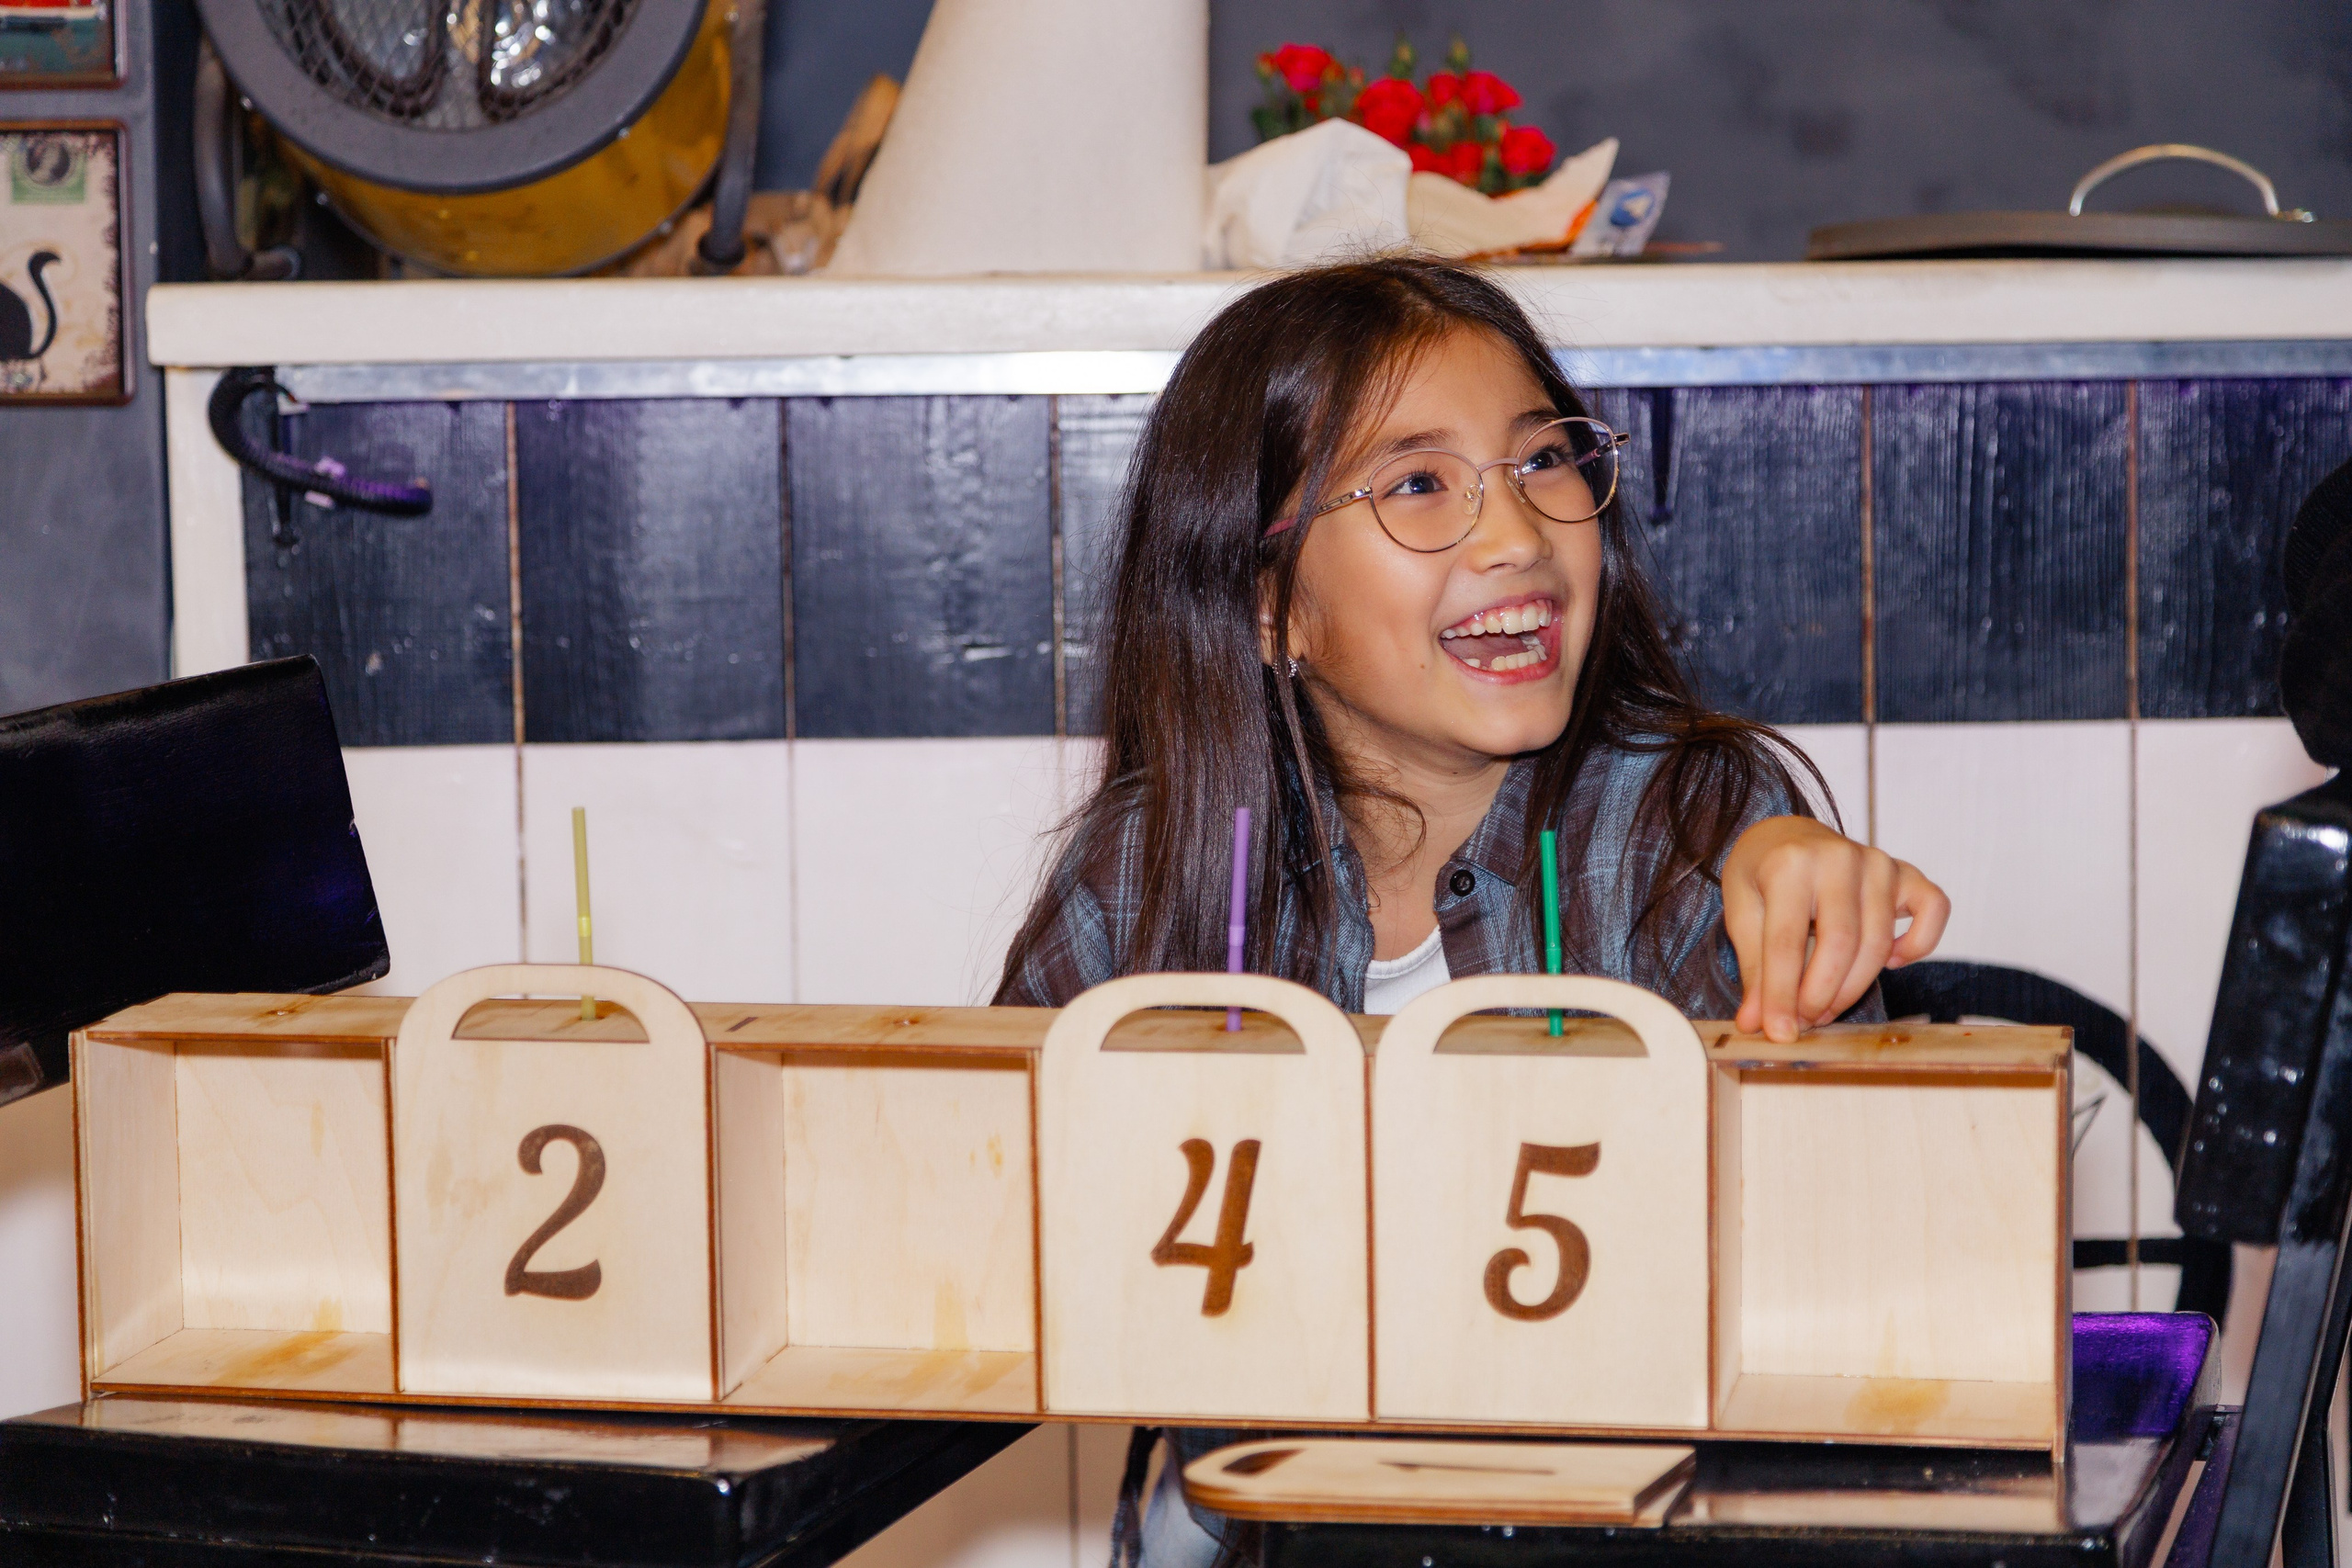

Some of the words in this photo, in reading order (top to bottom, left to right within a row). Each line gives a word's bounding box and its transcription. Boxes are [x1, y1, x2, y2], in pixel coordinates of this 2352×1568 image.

[503, 1123, 606, 1302] 2
[1150, 1137, 1261, 1317] 4
[1483, 1141, 1601, 1323] 5
